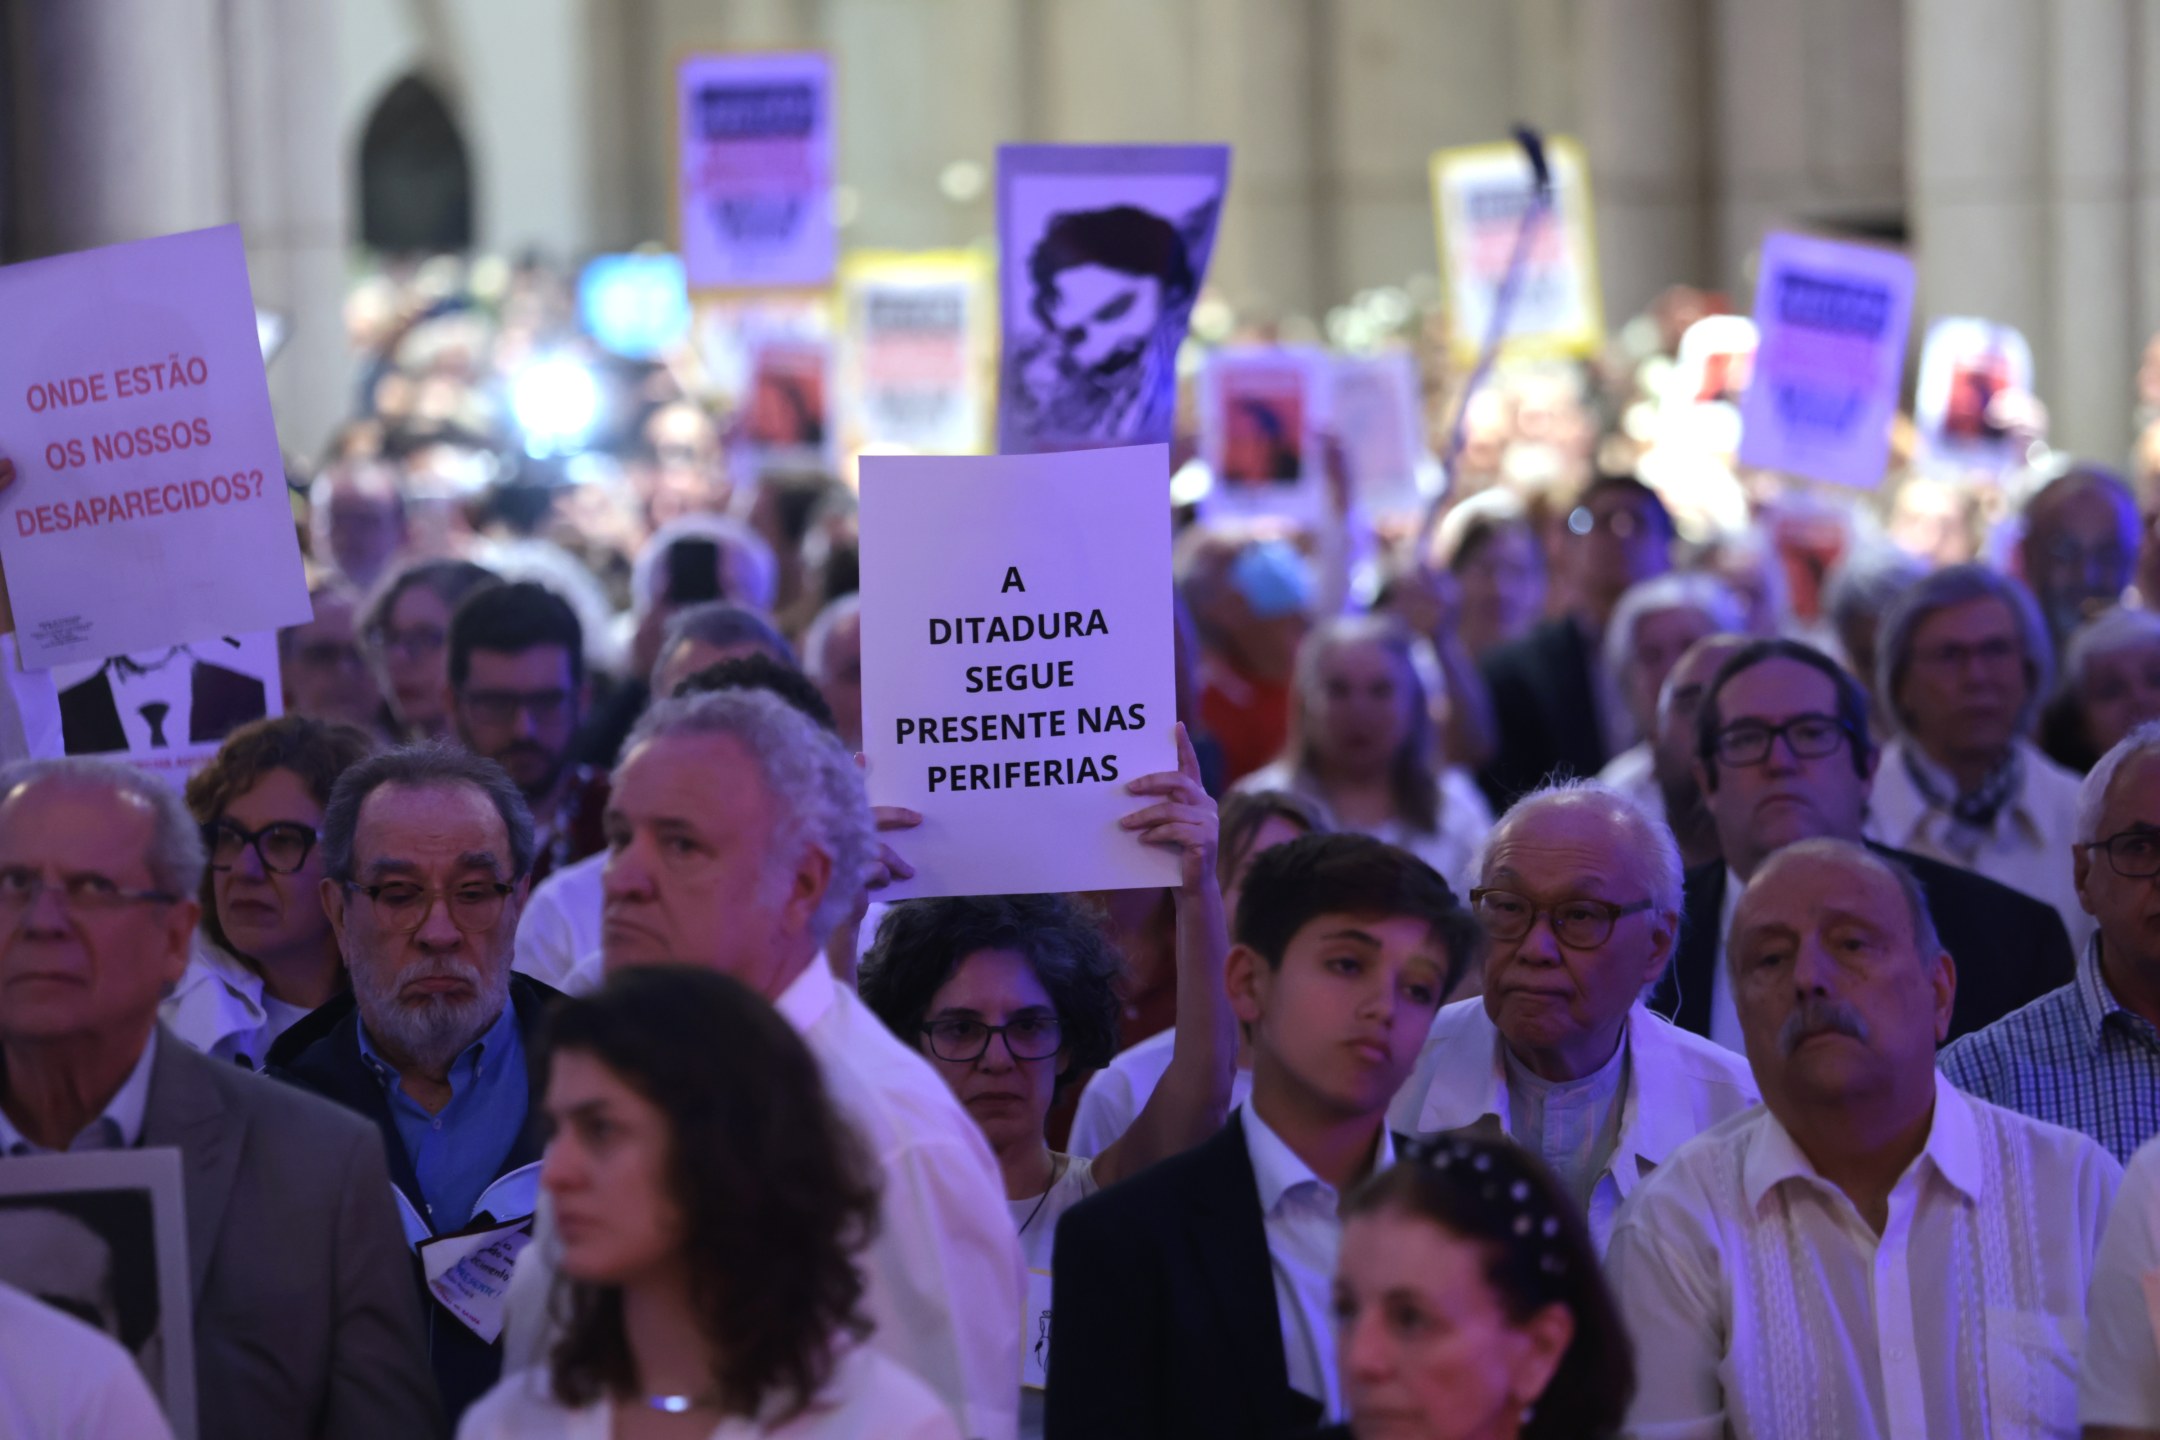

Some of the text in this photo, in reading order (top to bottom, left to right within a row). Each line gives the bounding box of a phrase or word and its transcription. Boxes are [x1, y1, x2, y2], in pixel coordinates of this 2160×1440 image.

[26, 353, 209, 414] ONDE ESTÃO
[45, 417, 212, 472] OS NOSSOS
[15, 469, 265, 537] DESAPARECIDOS?
[1000, 566, 1026, 594] A
[929, 608, 1109, 645] DITADURA
[965, 660, 1074, 694] SEGUE
[896, 703, 1146, 745] PRESENTE NAS
[927, 754, 1119, 793] PERIFERIAS
